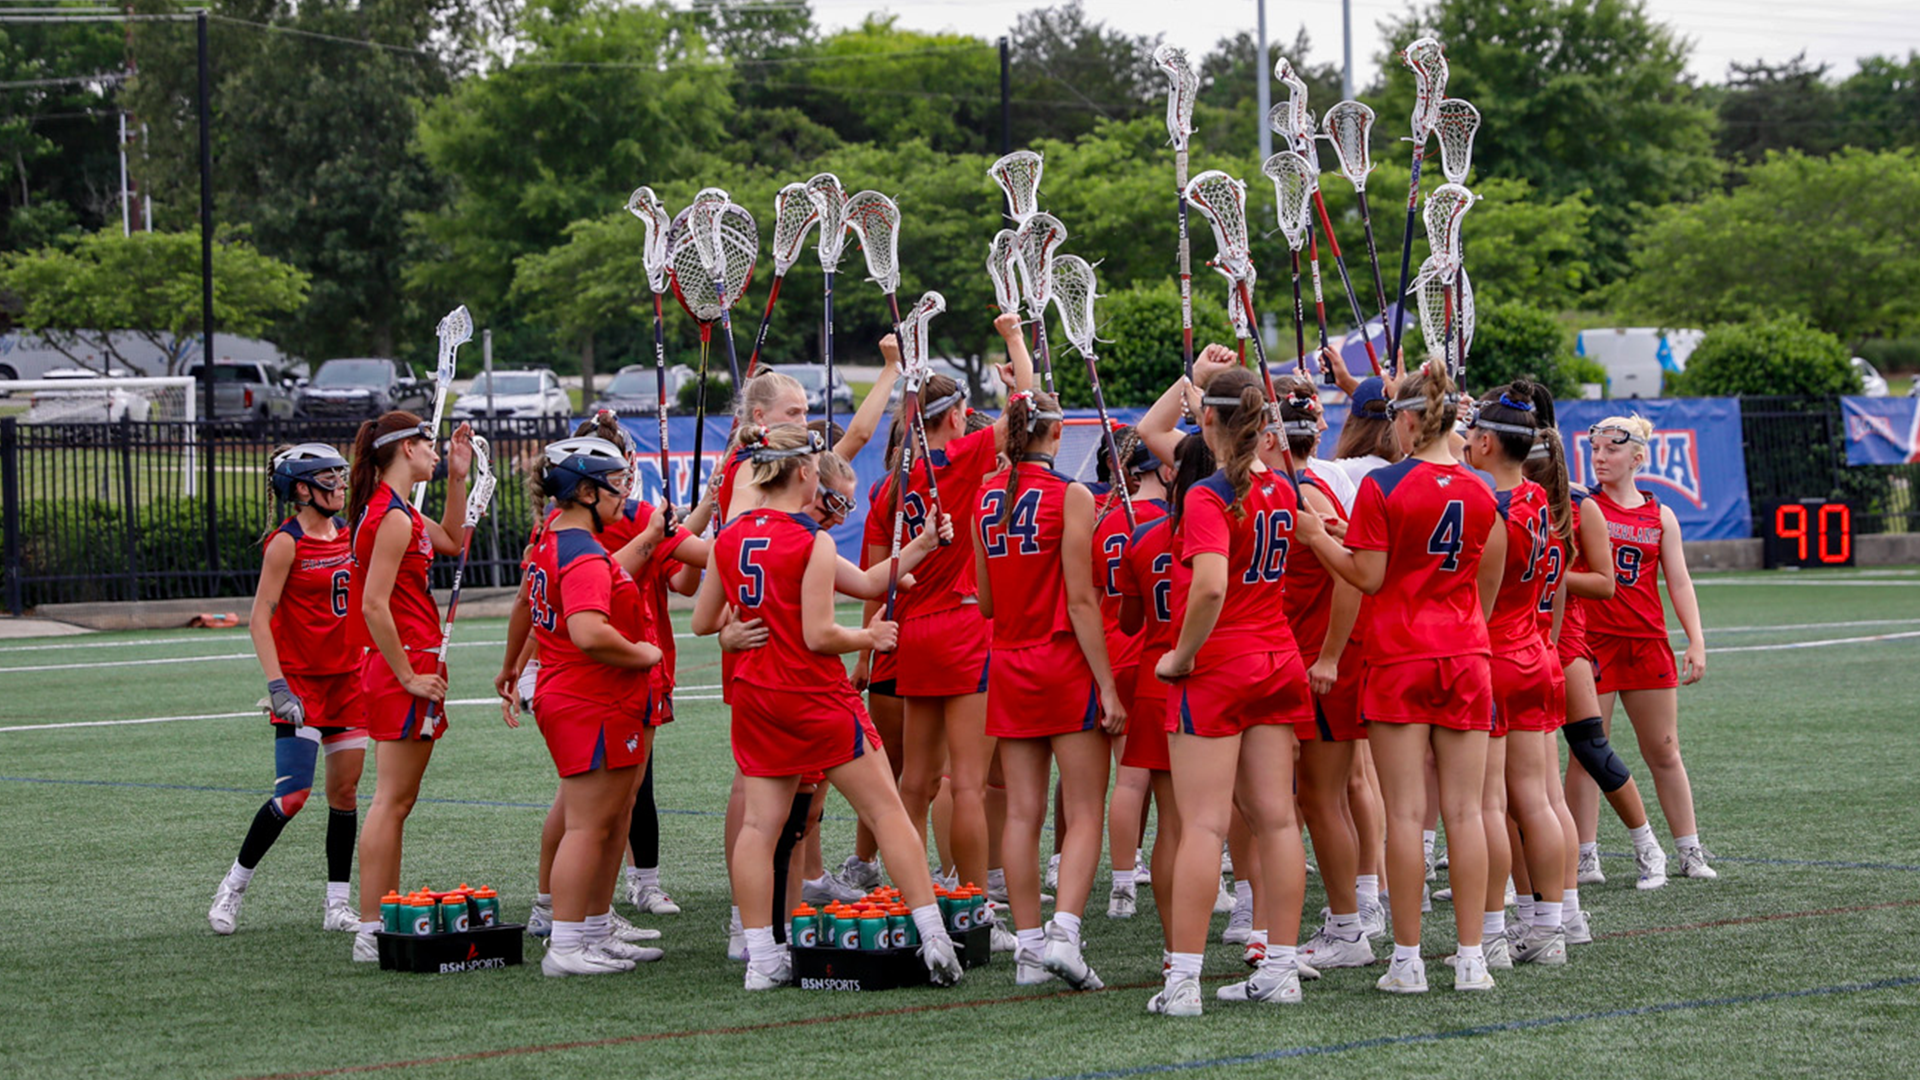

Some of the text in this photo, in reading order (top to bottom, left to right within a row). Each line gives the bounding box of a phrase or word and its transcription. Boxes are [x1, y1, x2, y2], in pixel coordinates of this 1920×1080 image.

[655, 342, 664, 367] GAIT
[902, 448, 911, 474] GAIT
[979, 488, 1043, 558] 24
[1427, 500, 1464, 572] 4
[1776, 504, 1850, 563] 90
[1243, 509, 1293, 584] 16
[738, 538, 770, 608] 5
[1611, 543, 1643, 587] 9
[331, 569, 351, 618] 6
[415, 917, 430, 935] G
[800, 928, 816, 947] G
[843, 930, 859, 949] G
[440, 958, 505, 974] BSN SPORTS
[801, 978, 861, 992] BSN SPORTS
